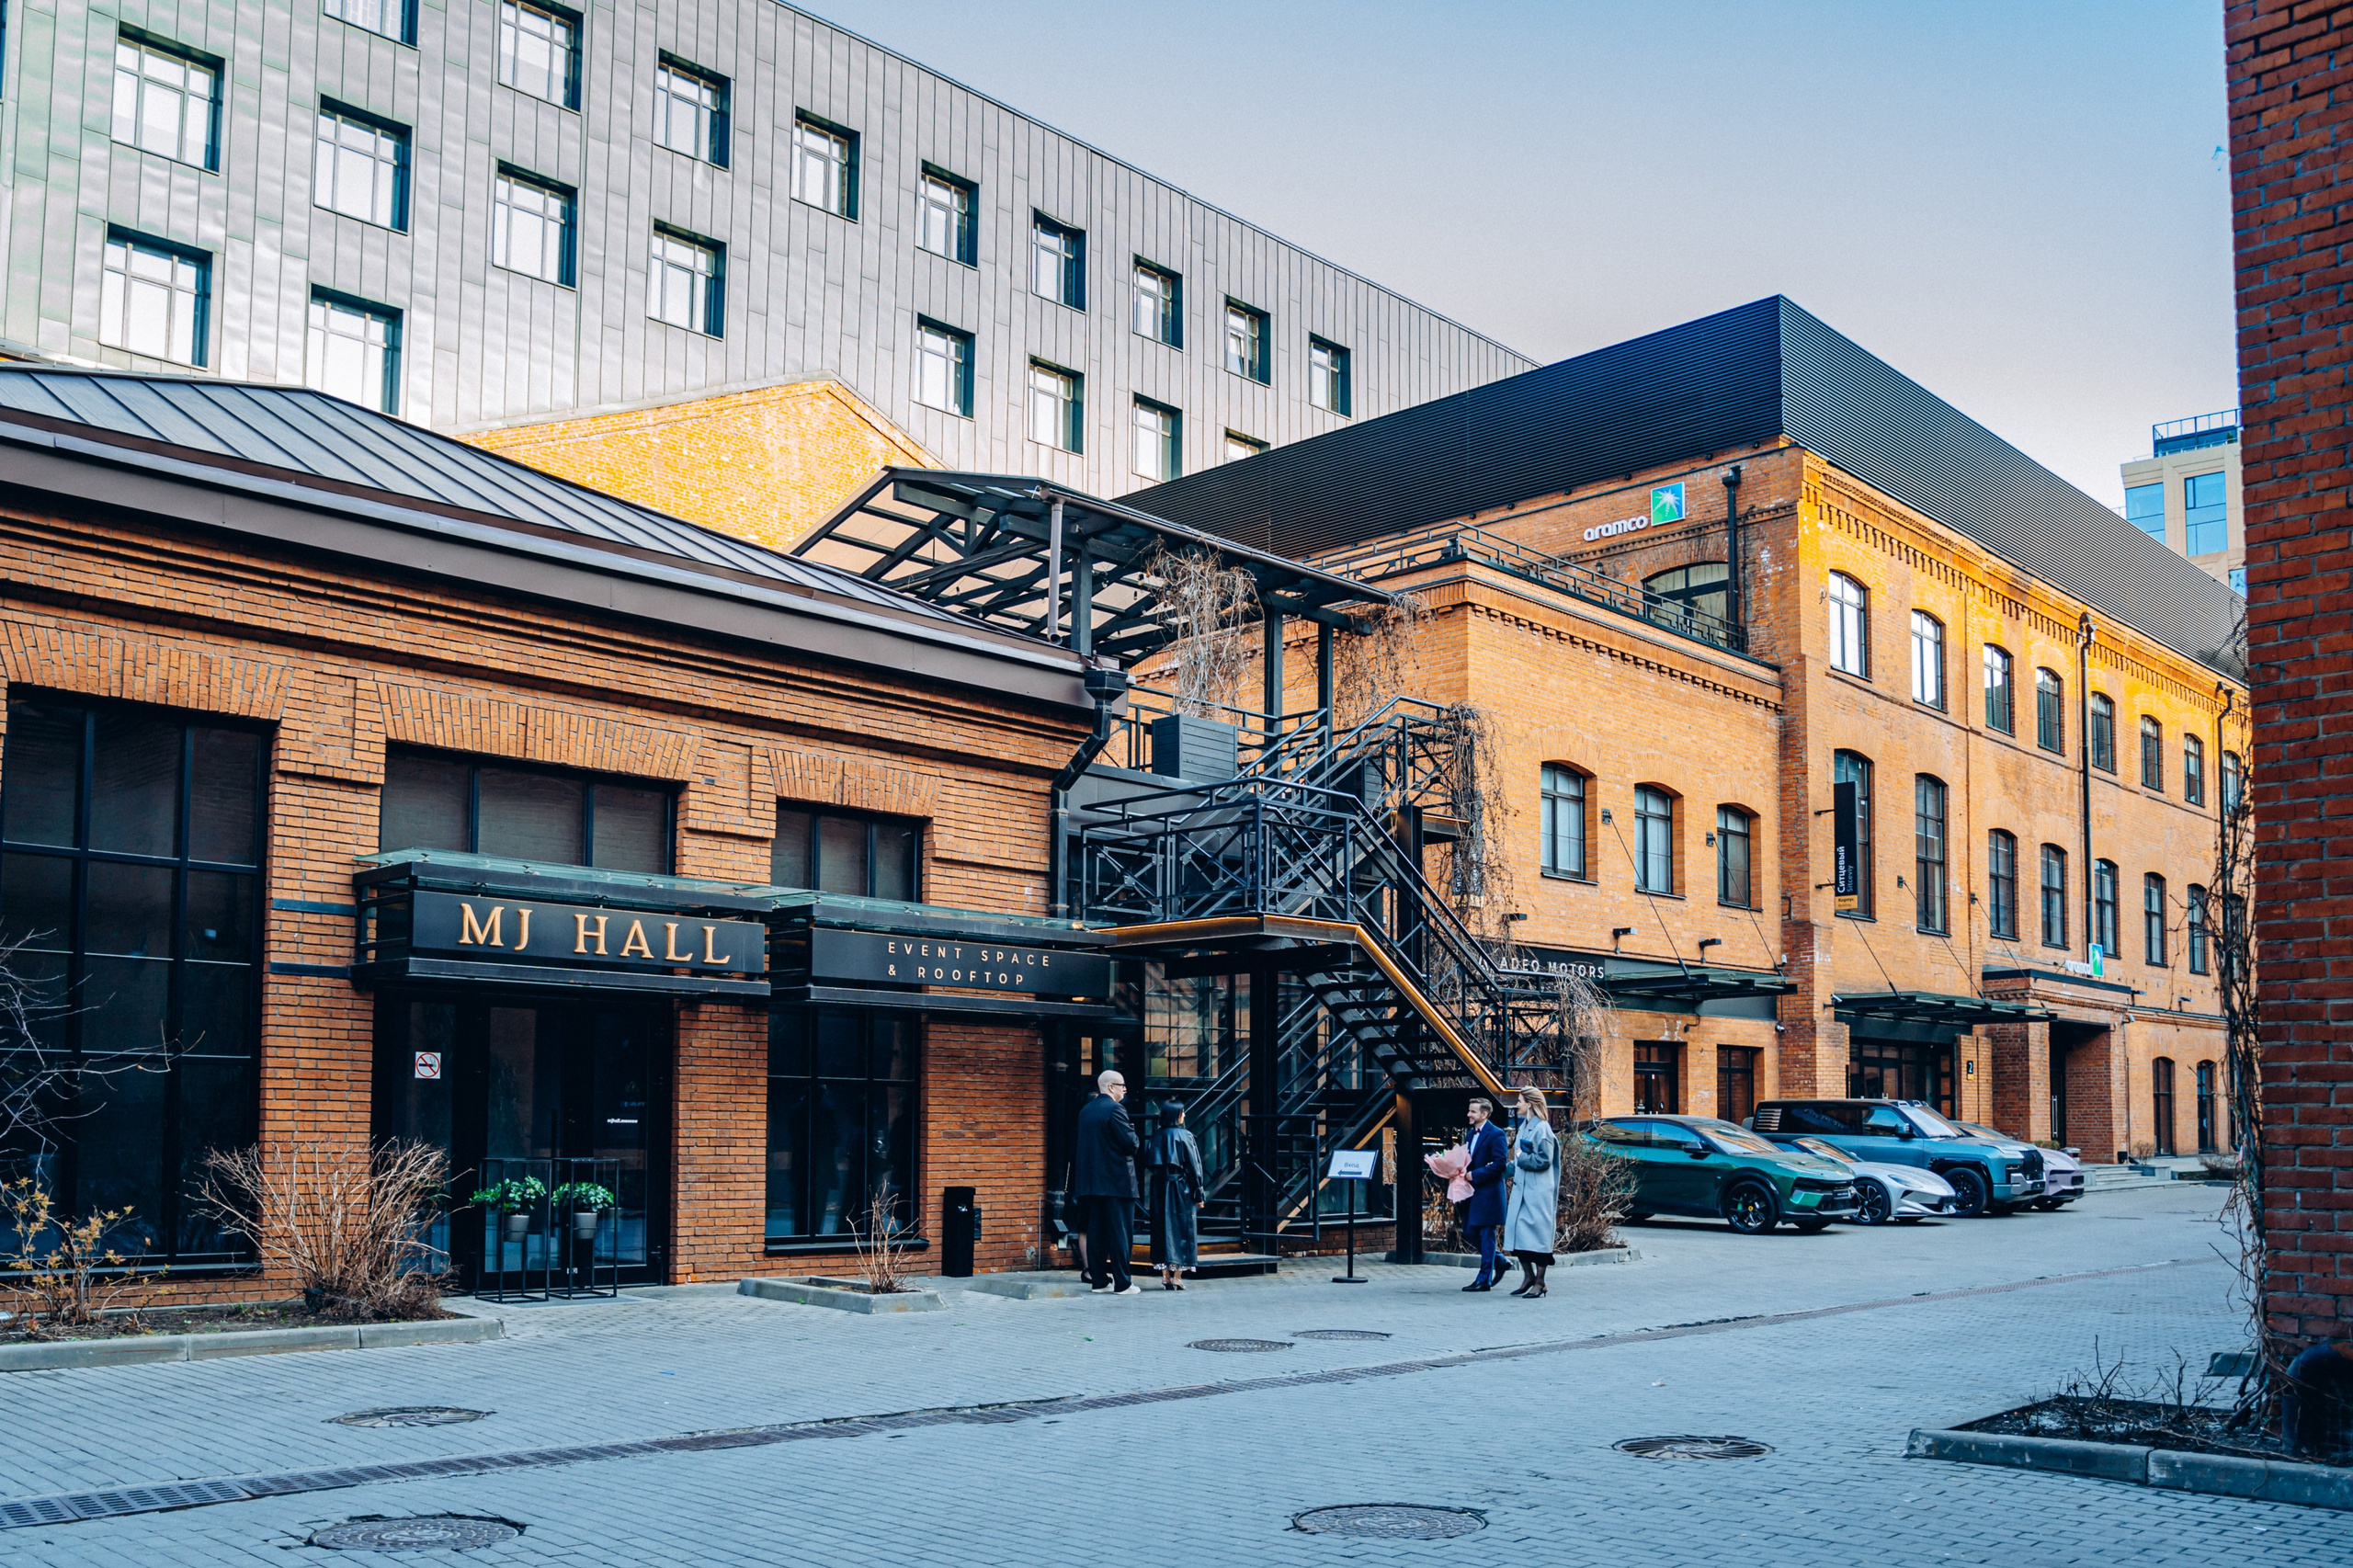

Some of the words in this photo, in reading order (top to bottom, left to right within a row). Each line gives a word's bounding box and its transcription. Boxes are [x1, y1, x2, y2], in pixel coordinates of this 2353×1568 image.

[1584, 516, 1648, 541] aramco
[1836, 846, 1846, 893] Ситцевый
[458, 903, 533, 951] MJ
[574, 914, 731, 964] HALL
[888, 941, 962, 960] EVENT
[981, 949, 1050, 967] SPACE
[888, 964, 896, 976] &
[917, 966, 1024, 985] ROOFTOP
[1548, 961, 1605, 979] MOTORS
[1968, 1062, 1973, 1074] 2
